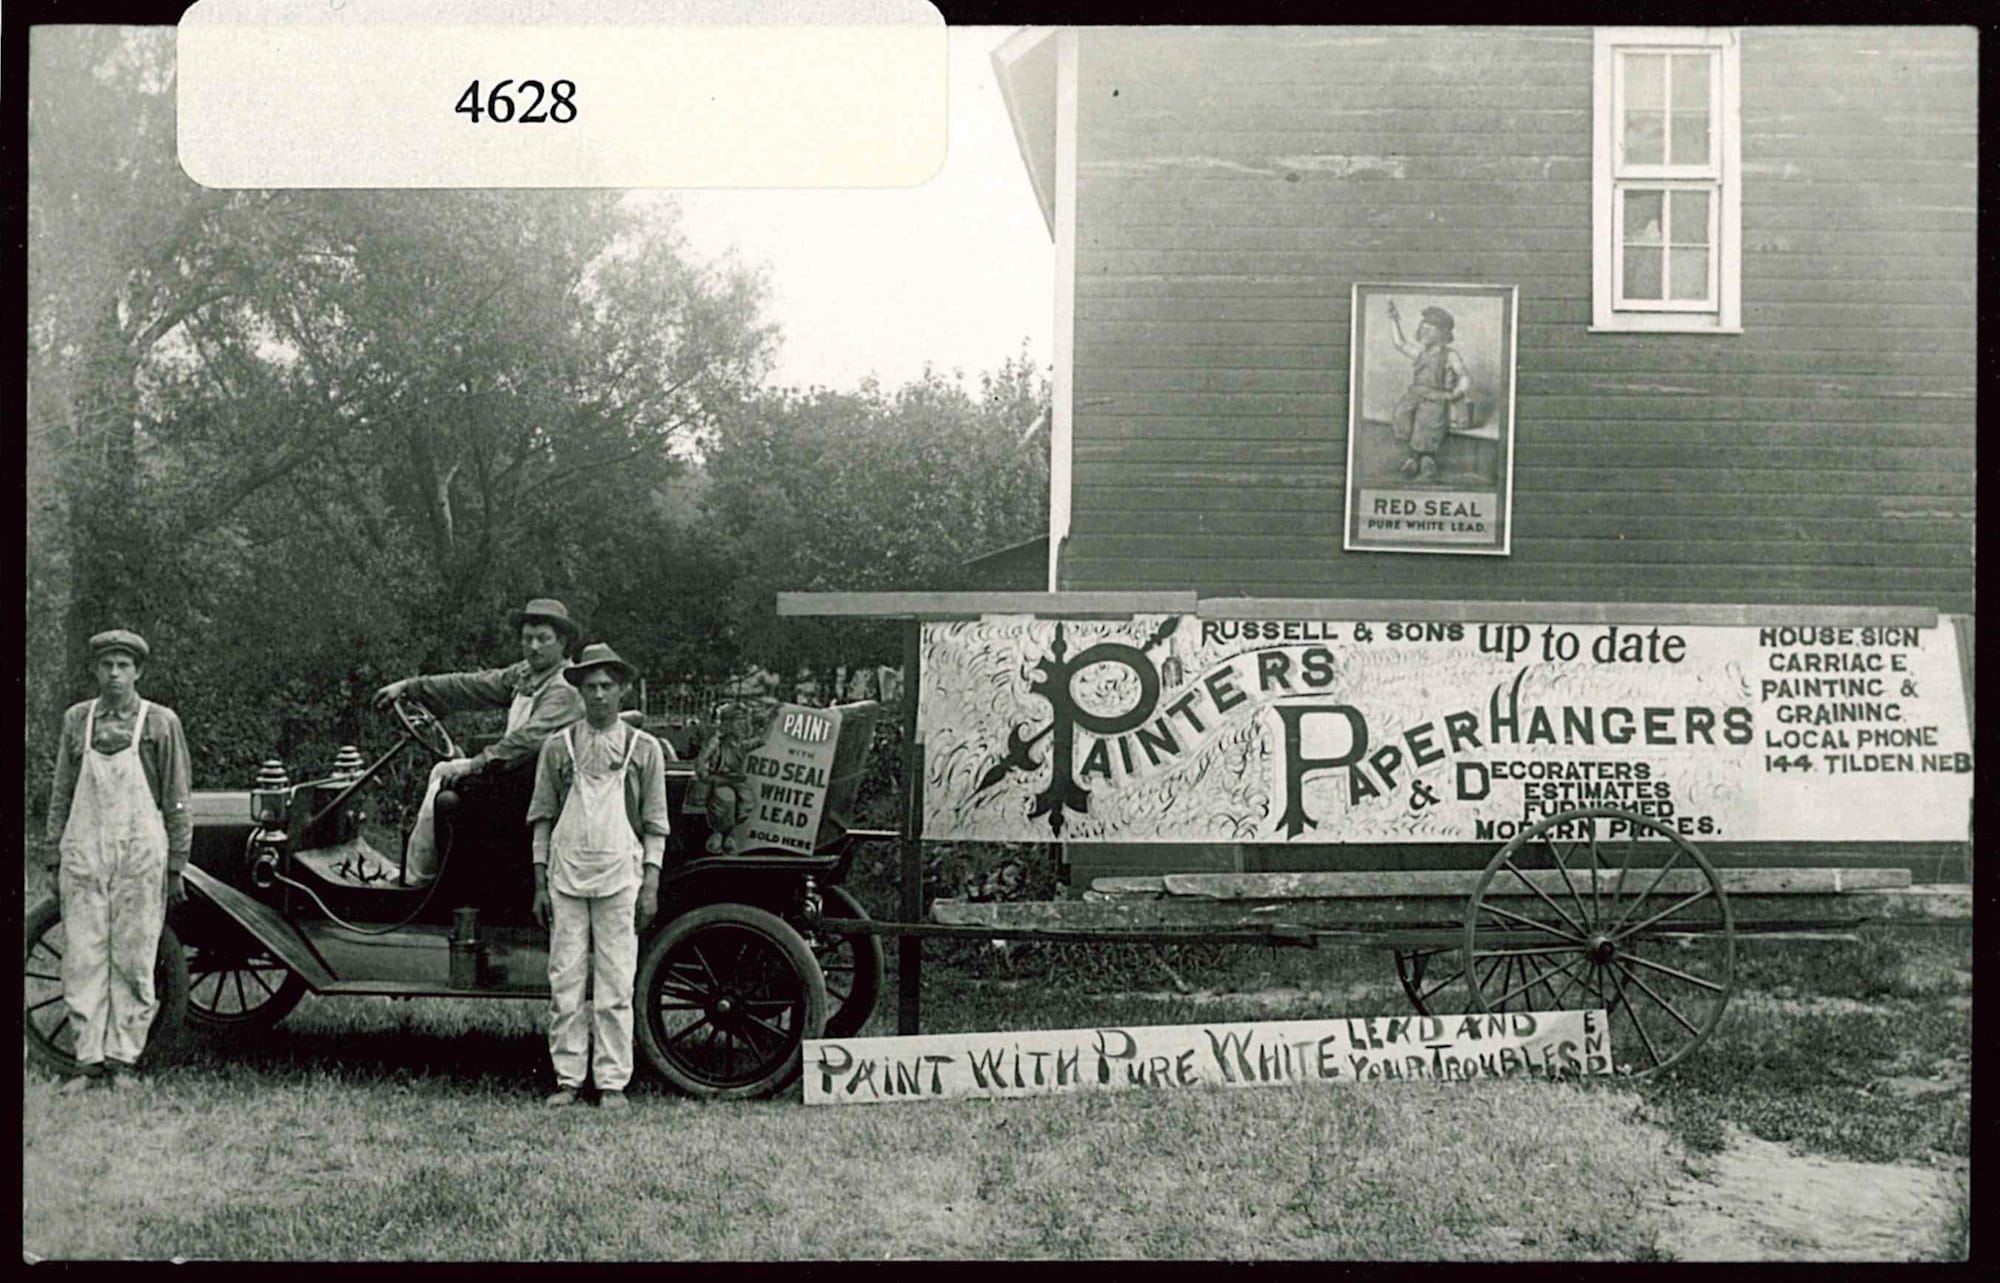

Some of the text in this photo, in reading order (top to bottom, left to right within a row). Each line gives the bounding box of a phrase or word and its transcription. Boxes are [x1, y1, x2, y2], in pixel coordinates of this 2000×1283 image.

[1374, 498, 1482, 518] RED SEAL
[1368, 519, 1401, 530] PURE
[1406, 519, 1444, 531] WHITE
[1202, 622, 1686, 664] RUSSELL & SONS up to date
[1899, 679, 1919, 698] &
[784, 714, 831, 742] PAINT
[977, 617, 1334, 838] PAINTERS
[1765, 726, 1938, 749] LOCAL PHONE
[745, 755, 826, 788] RED SEAL
[1921, 752, 1973, 773] NEB
[760, 783, 815, 808] WHITE
[1409, 761, 1650, 811] & DECORATERS
[1524, 782, 1671, 800] ESTIMATES
[759, 805, 808, 828] LEAD
[750, 830, 812, 850] SOLD HERE
[1346, 1012, 1537, 1050] LEAD AND
[1583, 1011, 1609, 1073] END
[1426, 1041, 1581, 1082] TROUBLES
